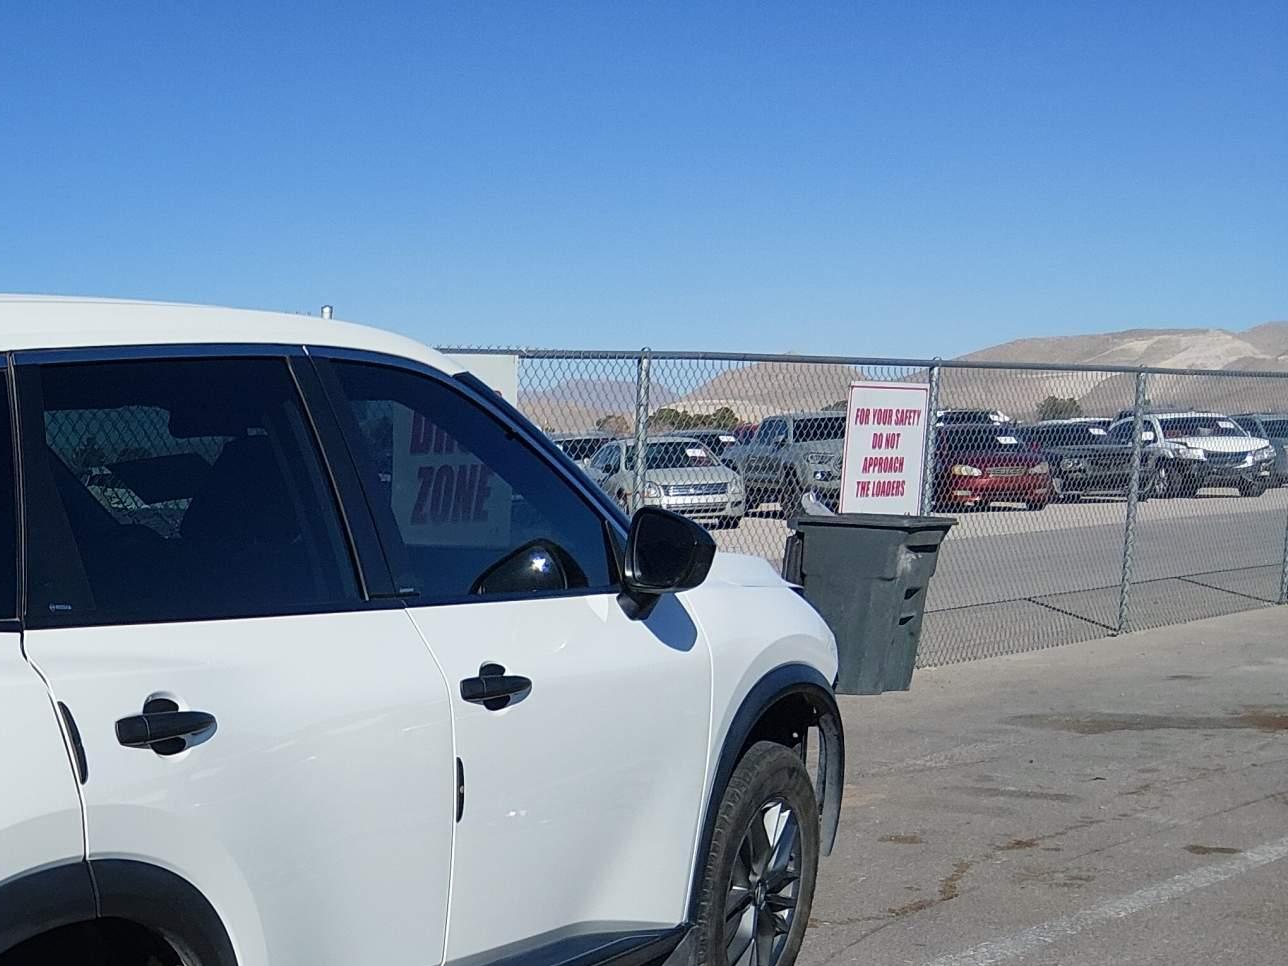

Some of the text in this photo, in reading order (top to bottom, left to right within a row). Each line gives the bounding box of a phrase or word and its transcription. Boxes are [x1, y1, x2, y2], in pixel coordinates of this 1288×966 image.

[855, 408, 921, 426] FOR YOUR SAFETY
[872, 432, 901, 450] DO NOT
[862, 456, 905, 474] APPROACH
[411, 464, 491, 525] ZONE
[856, 480, 906, 498] THE LOADERS
